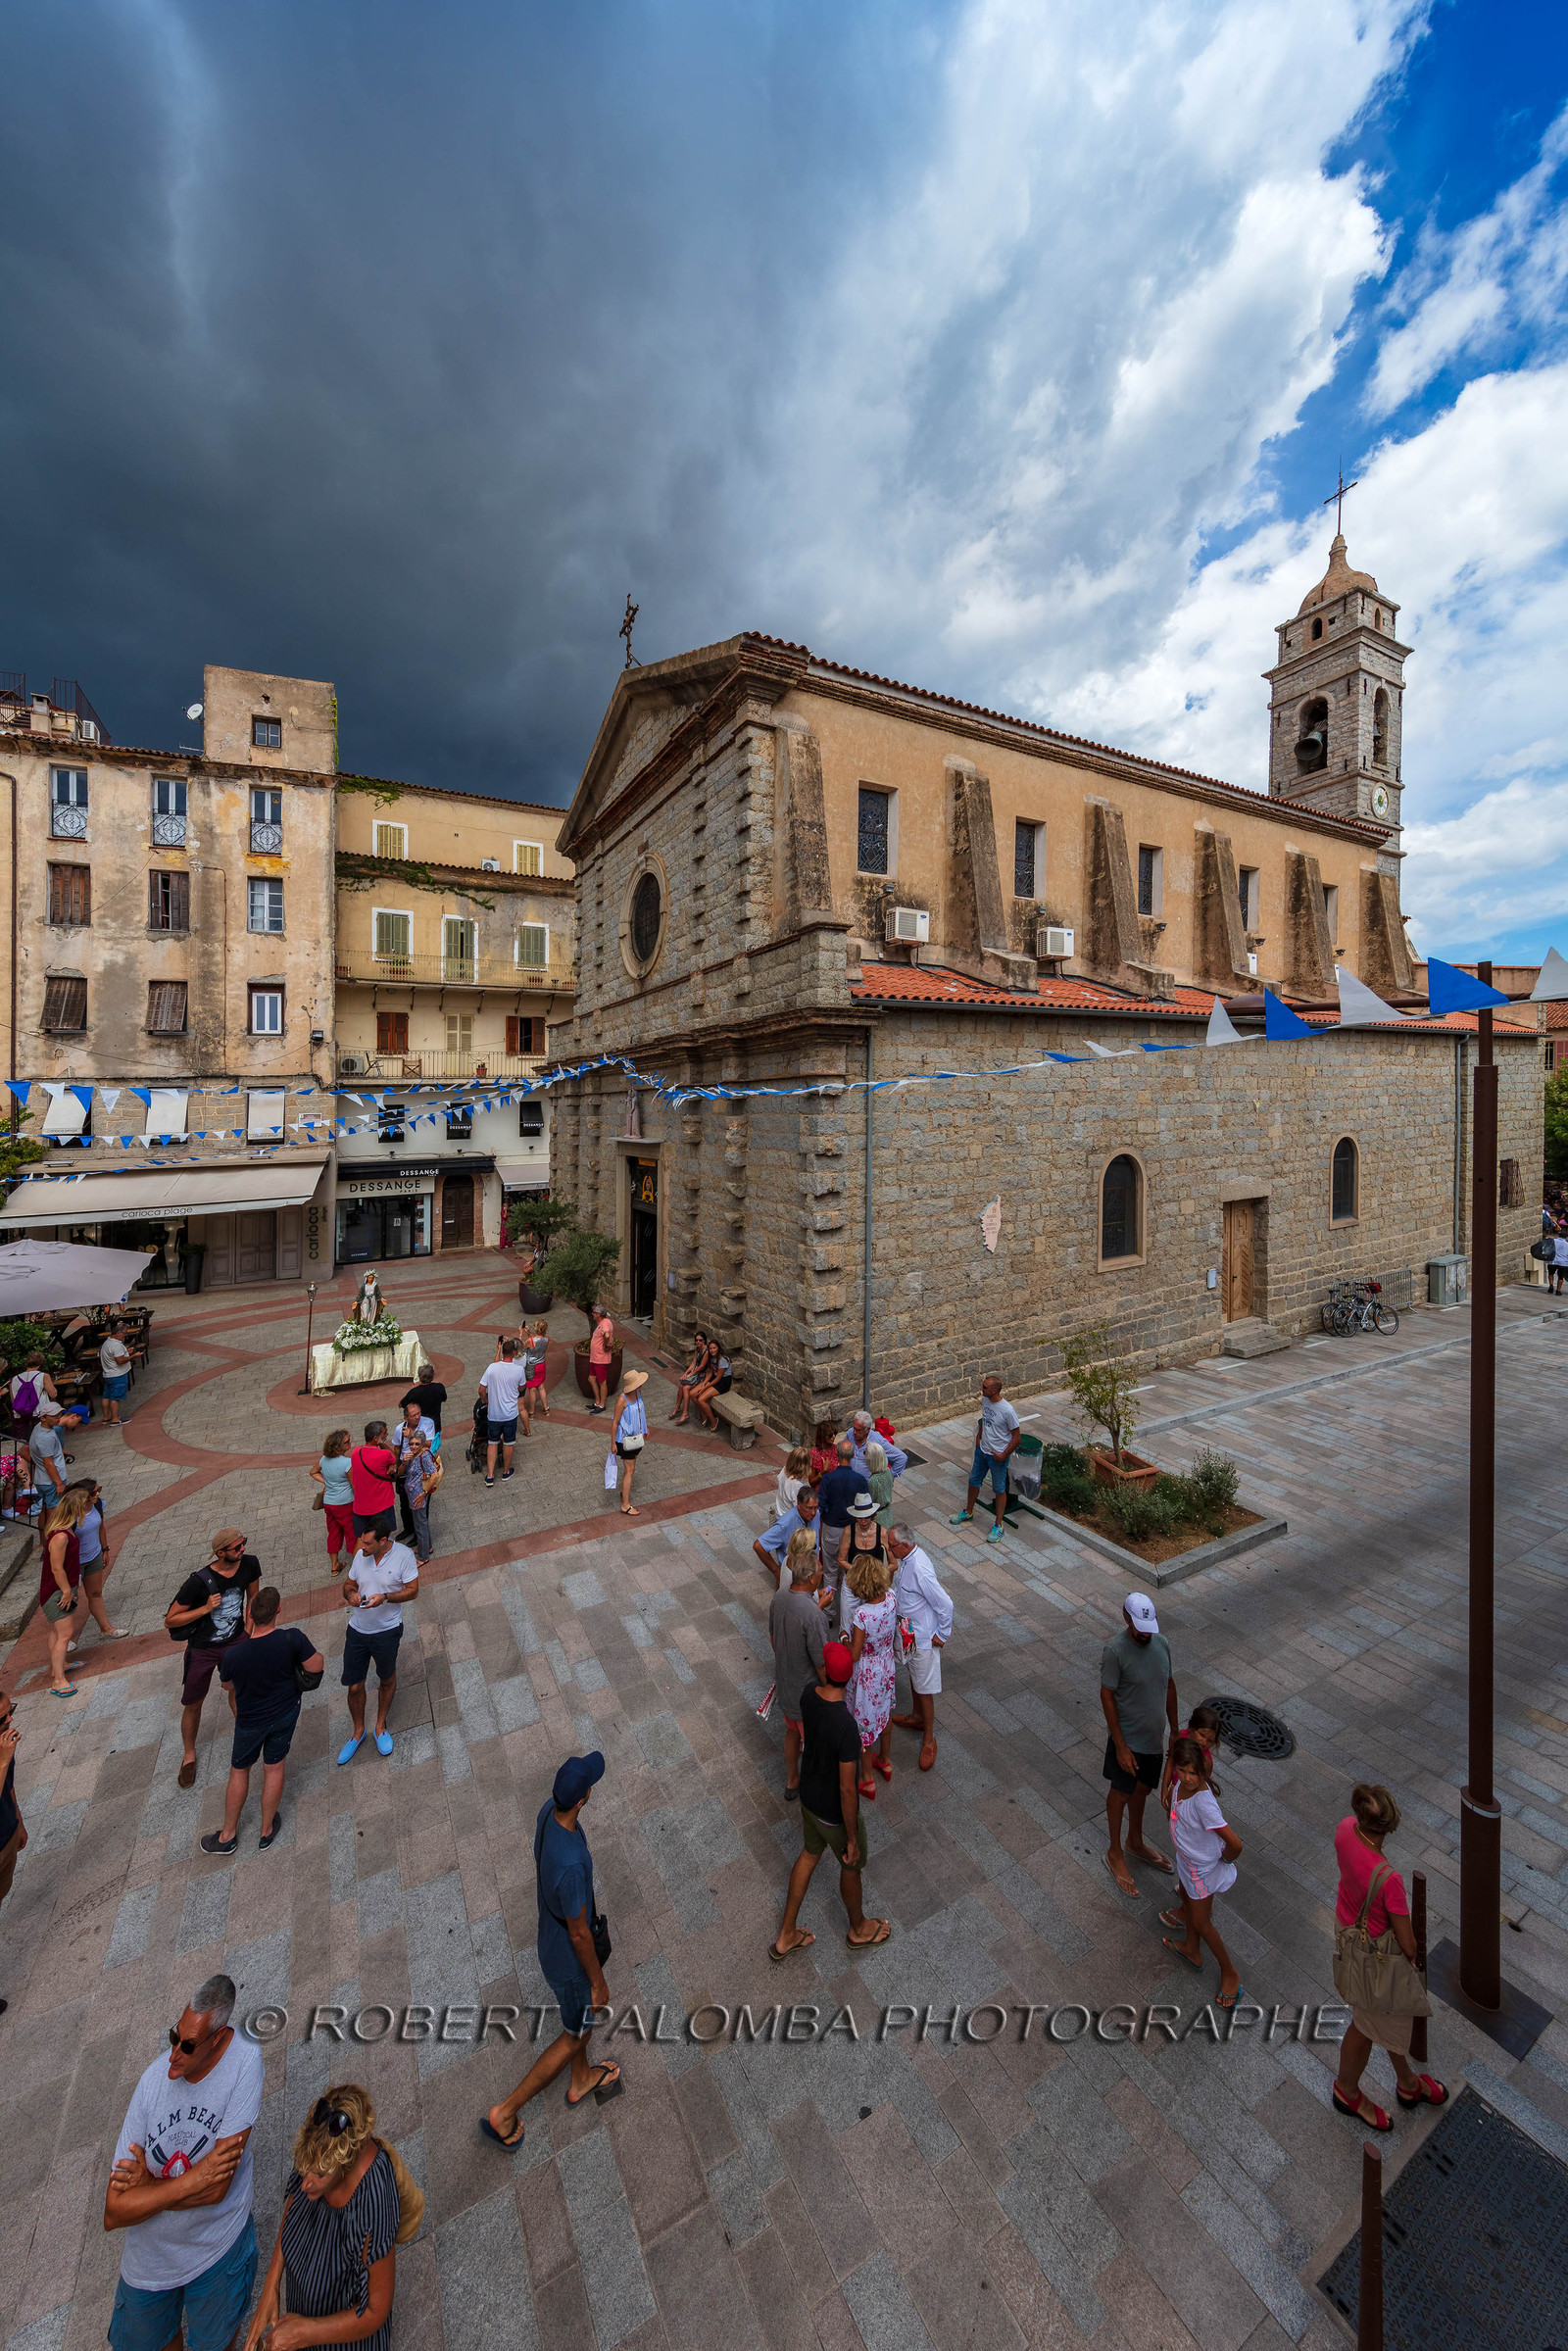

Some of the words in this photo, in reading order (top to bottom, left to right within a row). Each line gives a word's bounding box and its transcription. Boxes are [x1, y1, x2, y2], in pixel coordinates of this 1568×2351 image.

[349, 1179, 421, 1193] DESSANGE
[122, 1209, 161, 1218] carioca
[164, 1207, 193, 1216] plage
[306, 1206, 318, 1260] carioca
[144, 2109, 181, 2149] ALM
